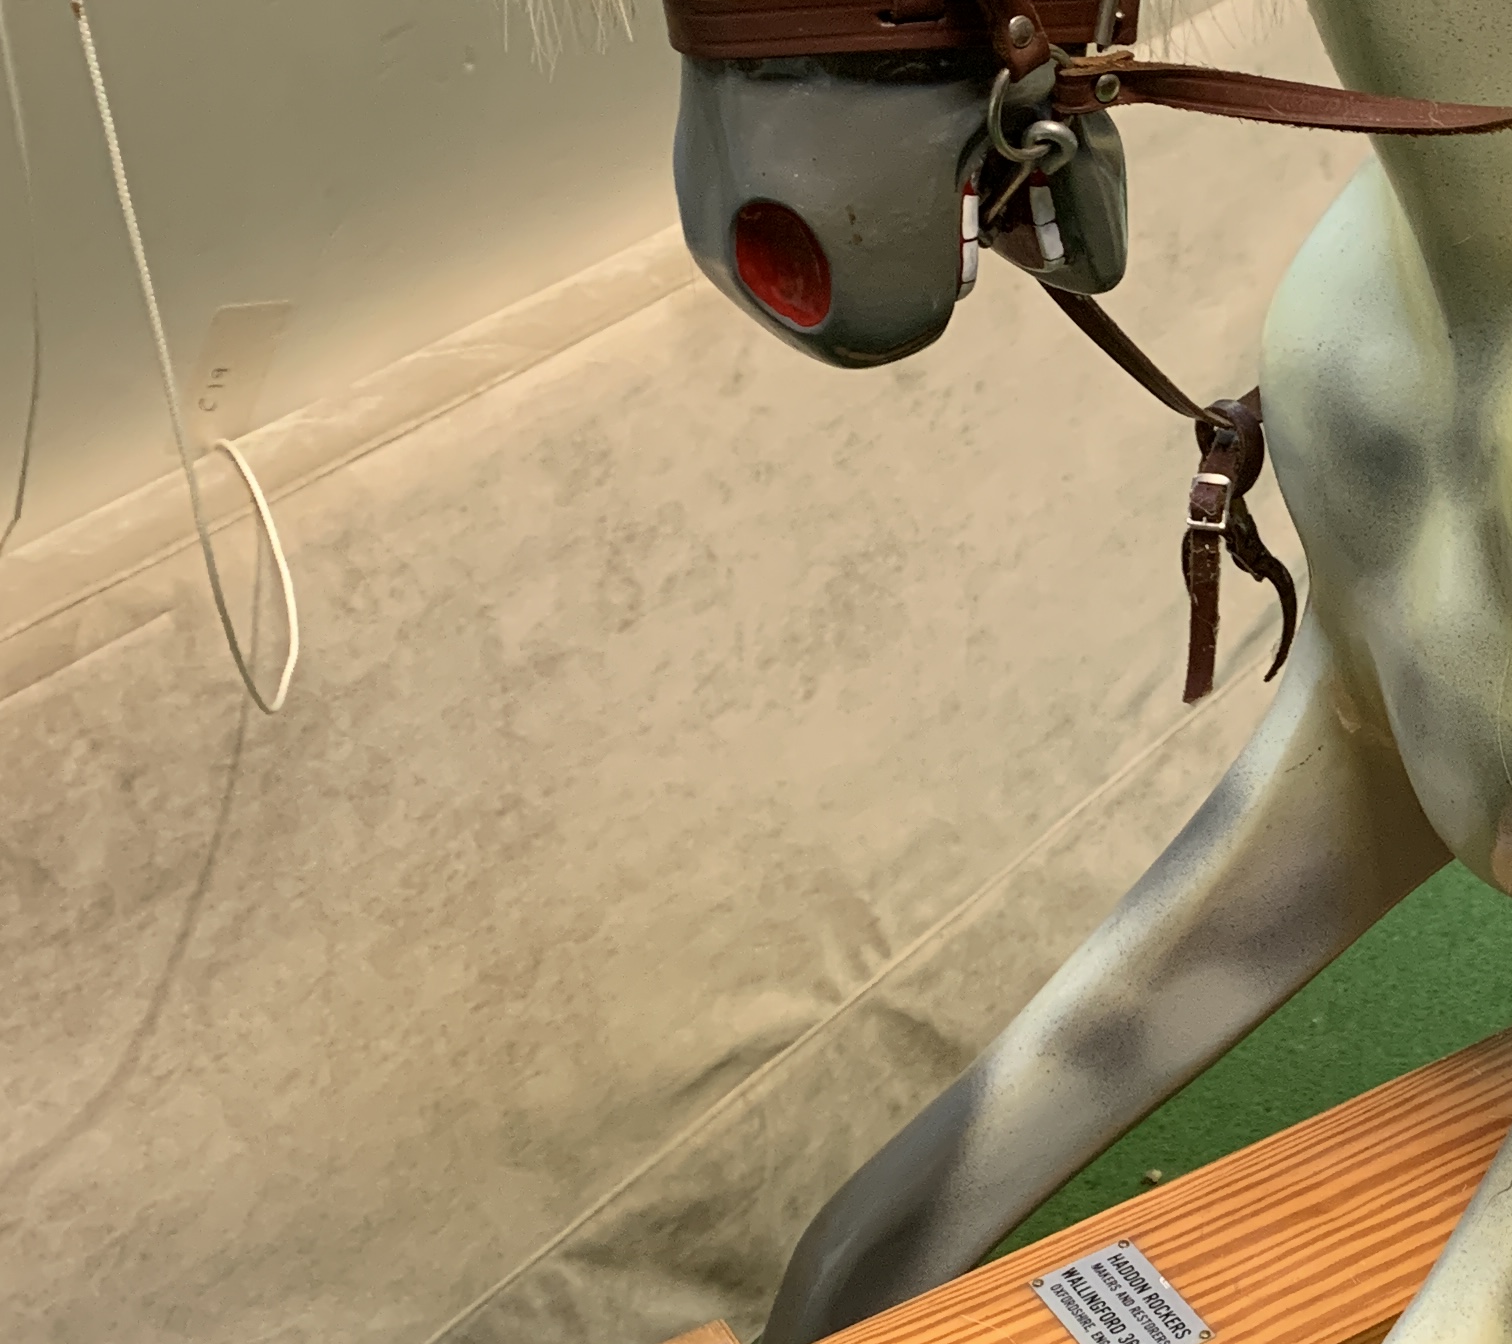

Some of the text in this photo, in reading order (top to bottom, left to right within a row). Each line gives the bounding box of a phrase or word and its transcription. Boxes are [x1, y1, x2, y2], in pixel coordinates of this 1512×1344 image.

[1050, 1283, 1097, 1334] OXFORDSHIRE,
[1060, 1266, 1126, 1335] WALLINGFORD
[1091, 1262, 1122, 1293] MAKERS
[1116, 1290, 1136, 1307] AND
[1107, 1252, 1192, 1340] HADDON ROCKERS
